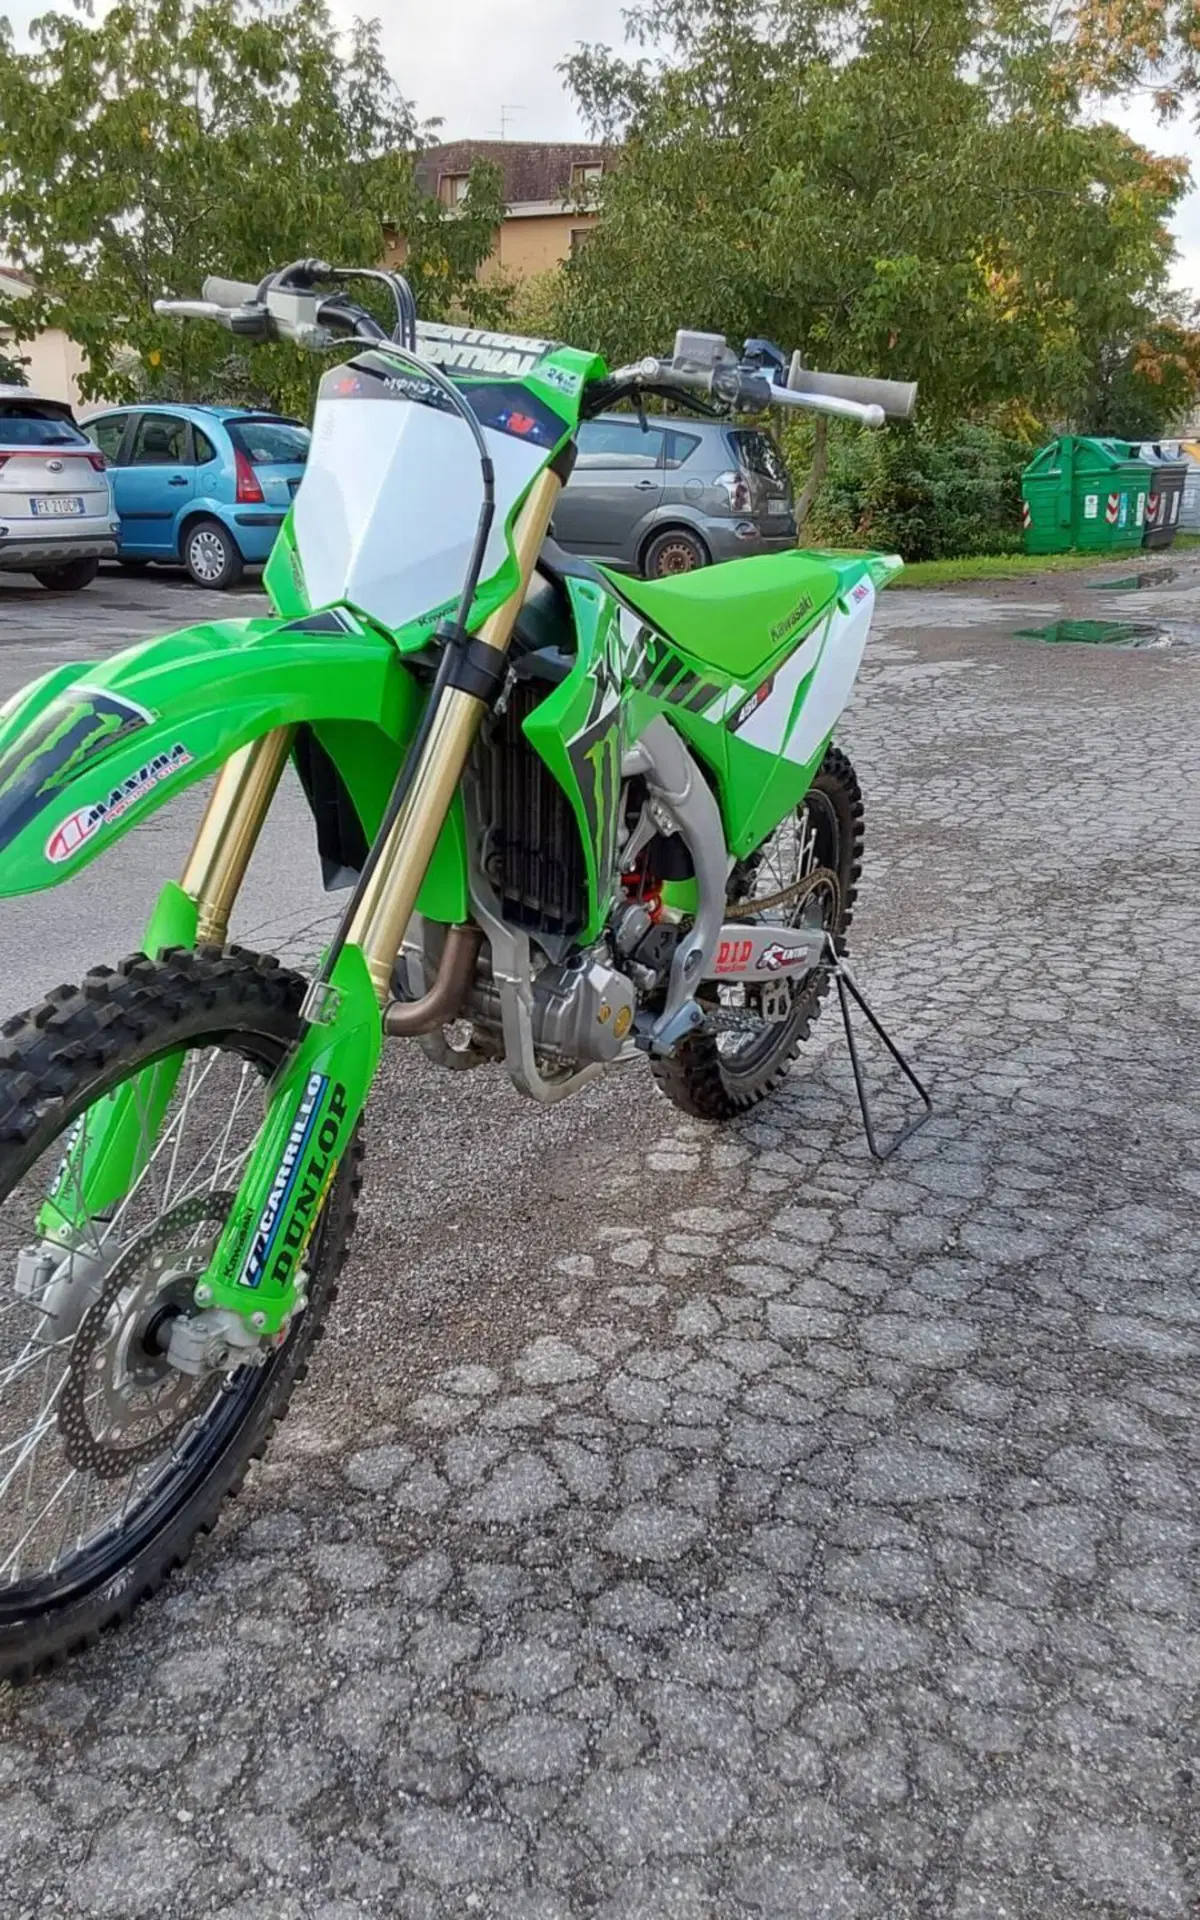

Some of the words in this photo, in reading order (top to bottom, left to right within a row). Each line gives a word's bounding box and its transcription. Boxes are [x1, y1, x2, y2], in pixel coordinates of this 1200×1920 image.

[259, 1073, 322, 1233] CARRILLO
[271, 1081, 347, 1288] DUNLOP
[223, 1207, 256, 1279] Kawasaki
